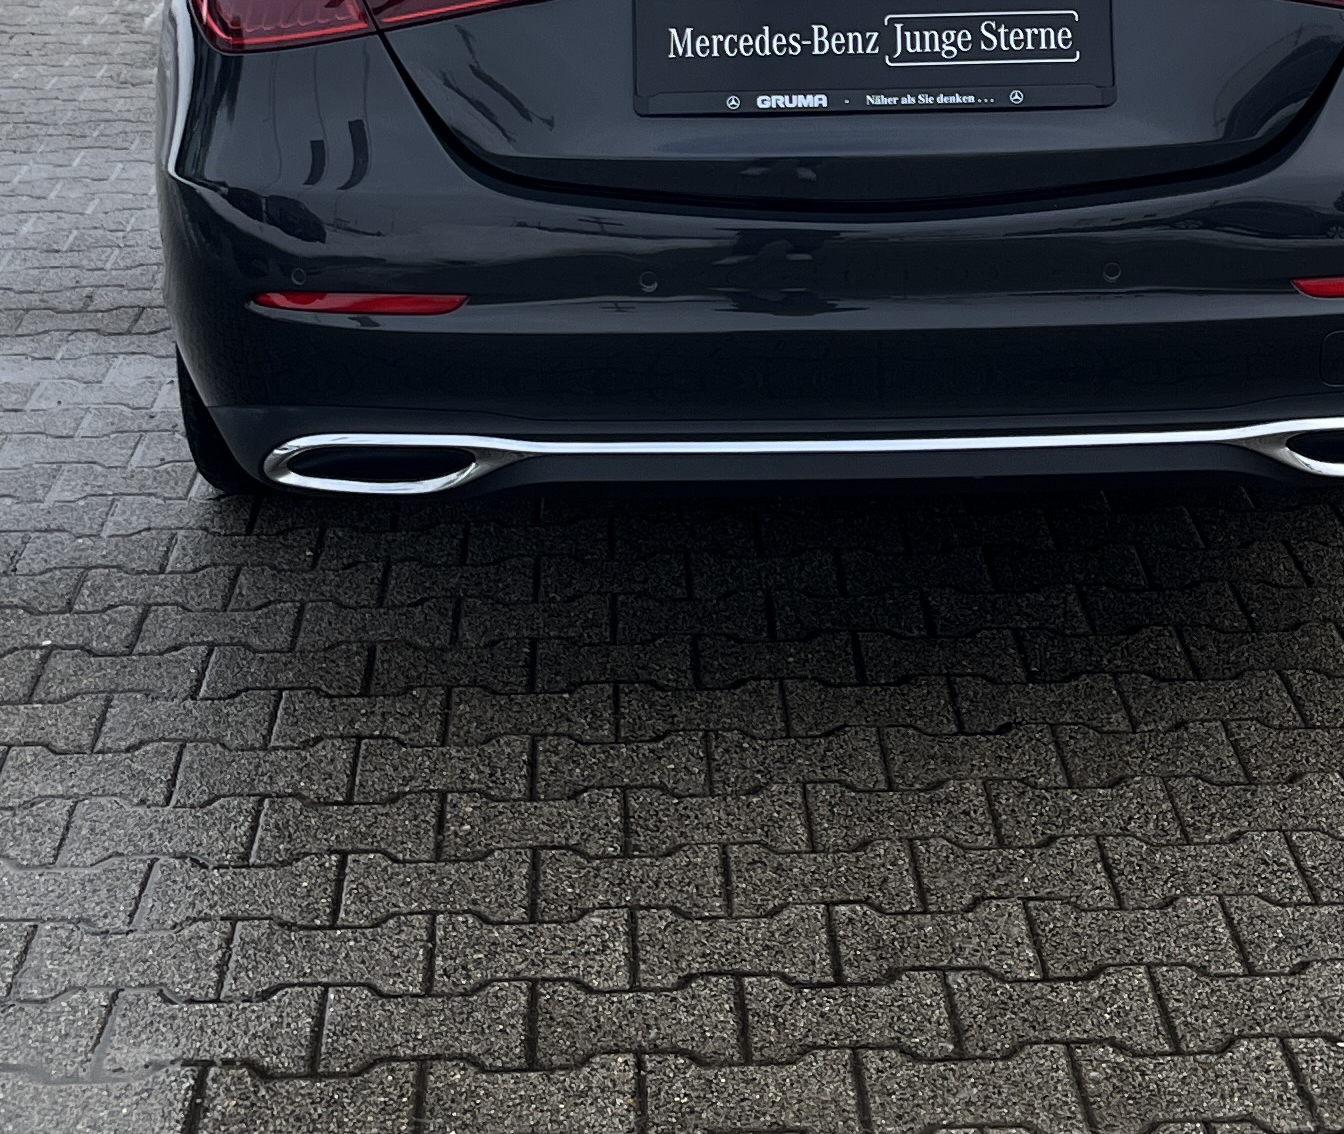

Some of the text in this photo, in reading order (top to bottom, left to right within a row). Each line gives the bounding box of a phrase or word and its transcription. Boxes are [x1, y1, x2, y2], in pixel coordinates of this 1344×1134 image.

[667, 20, 1073, 59] Mercedes-Benz Junge Sterne
[756, 94, 828, 109] GRUMA
[866, 94, 899, 105] Näher
[900, 94, 916, 105] als
[917, 93, 935, 104] Sie
[936, 93, 975, 104] denken
